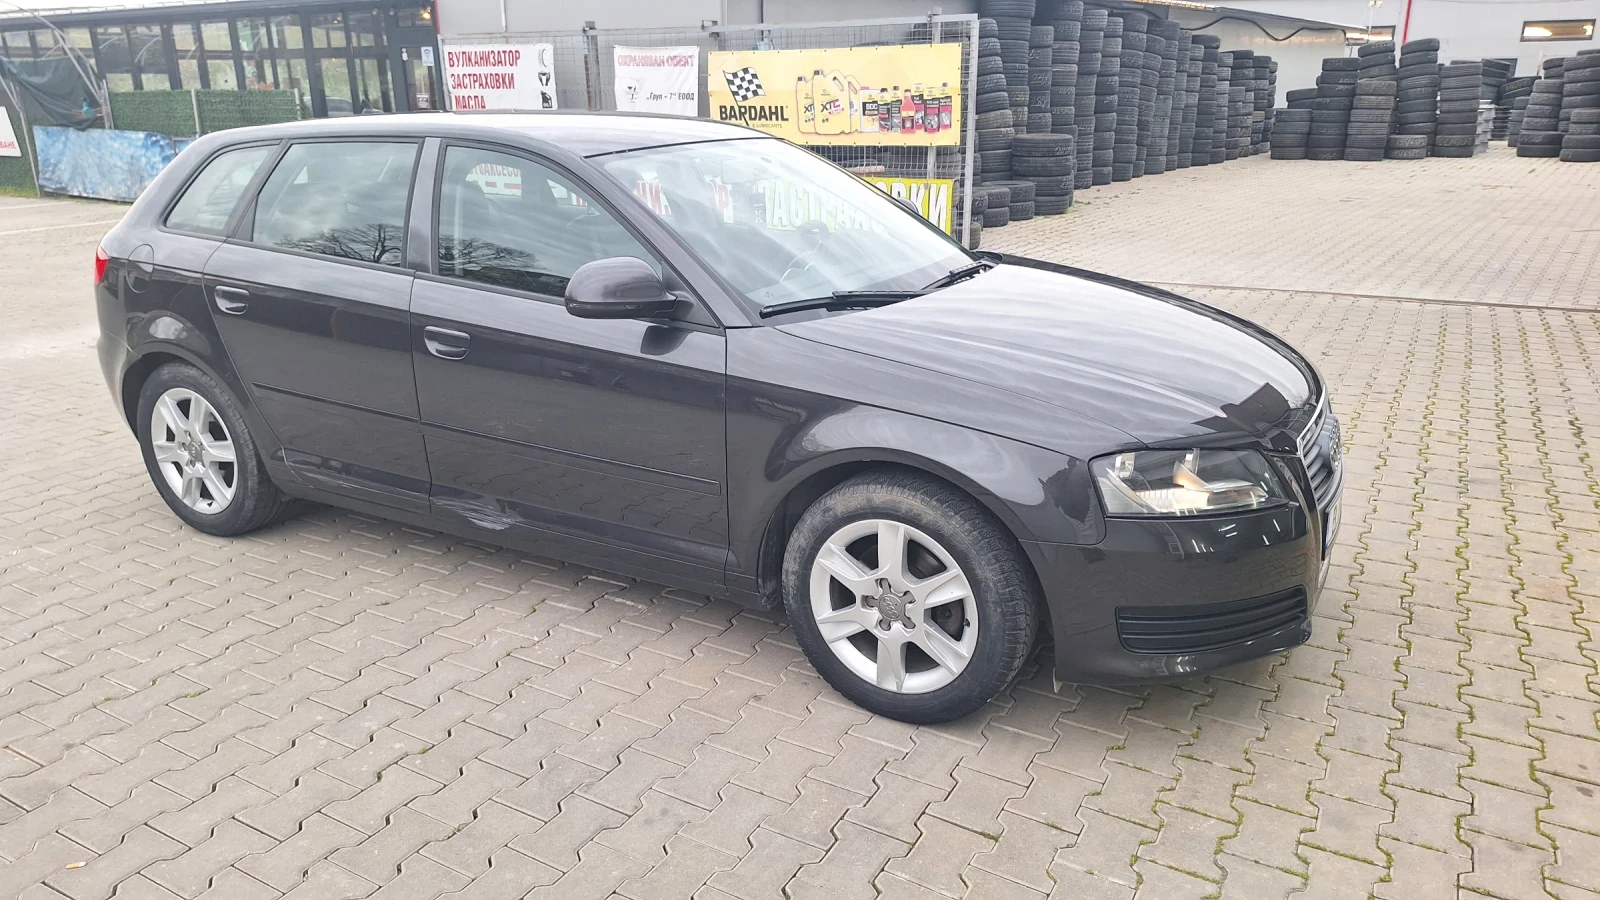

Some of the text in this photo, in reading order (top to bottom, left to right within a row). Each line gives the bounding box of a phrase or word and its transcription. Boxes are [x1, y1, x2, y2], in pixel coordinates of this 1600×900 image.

[448, 50, 521, 67] ВУЛКАНИЗАТОР
[617, 54, 696, 67] ОХРАНЯВАН ОБЕКТ
[450, 72, 515, 89] ЗАСТРАХОВКИ
[454, 95, 486, 109] МАСЛА
[678, 92, 695, 101] ЕООД
[719, 104, 789, 122] BARDAHL
[820, 98, 842, 113] XTC
